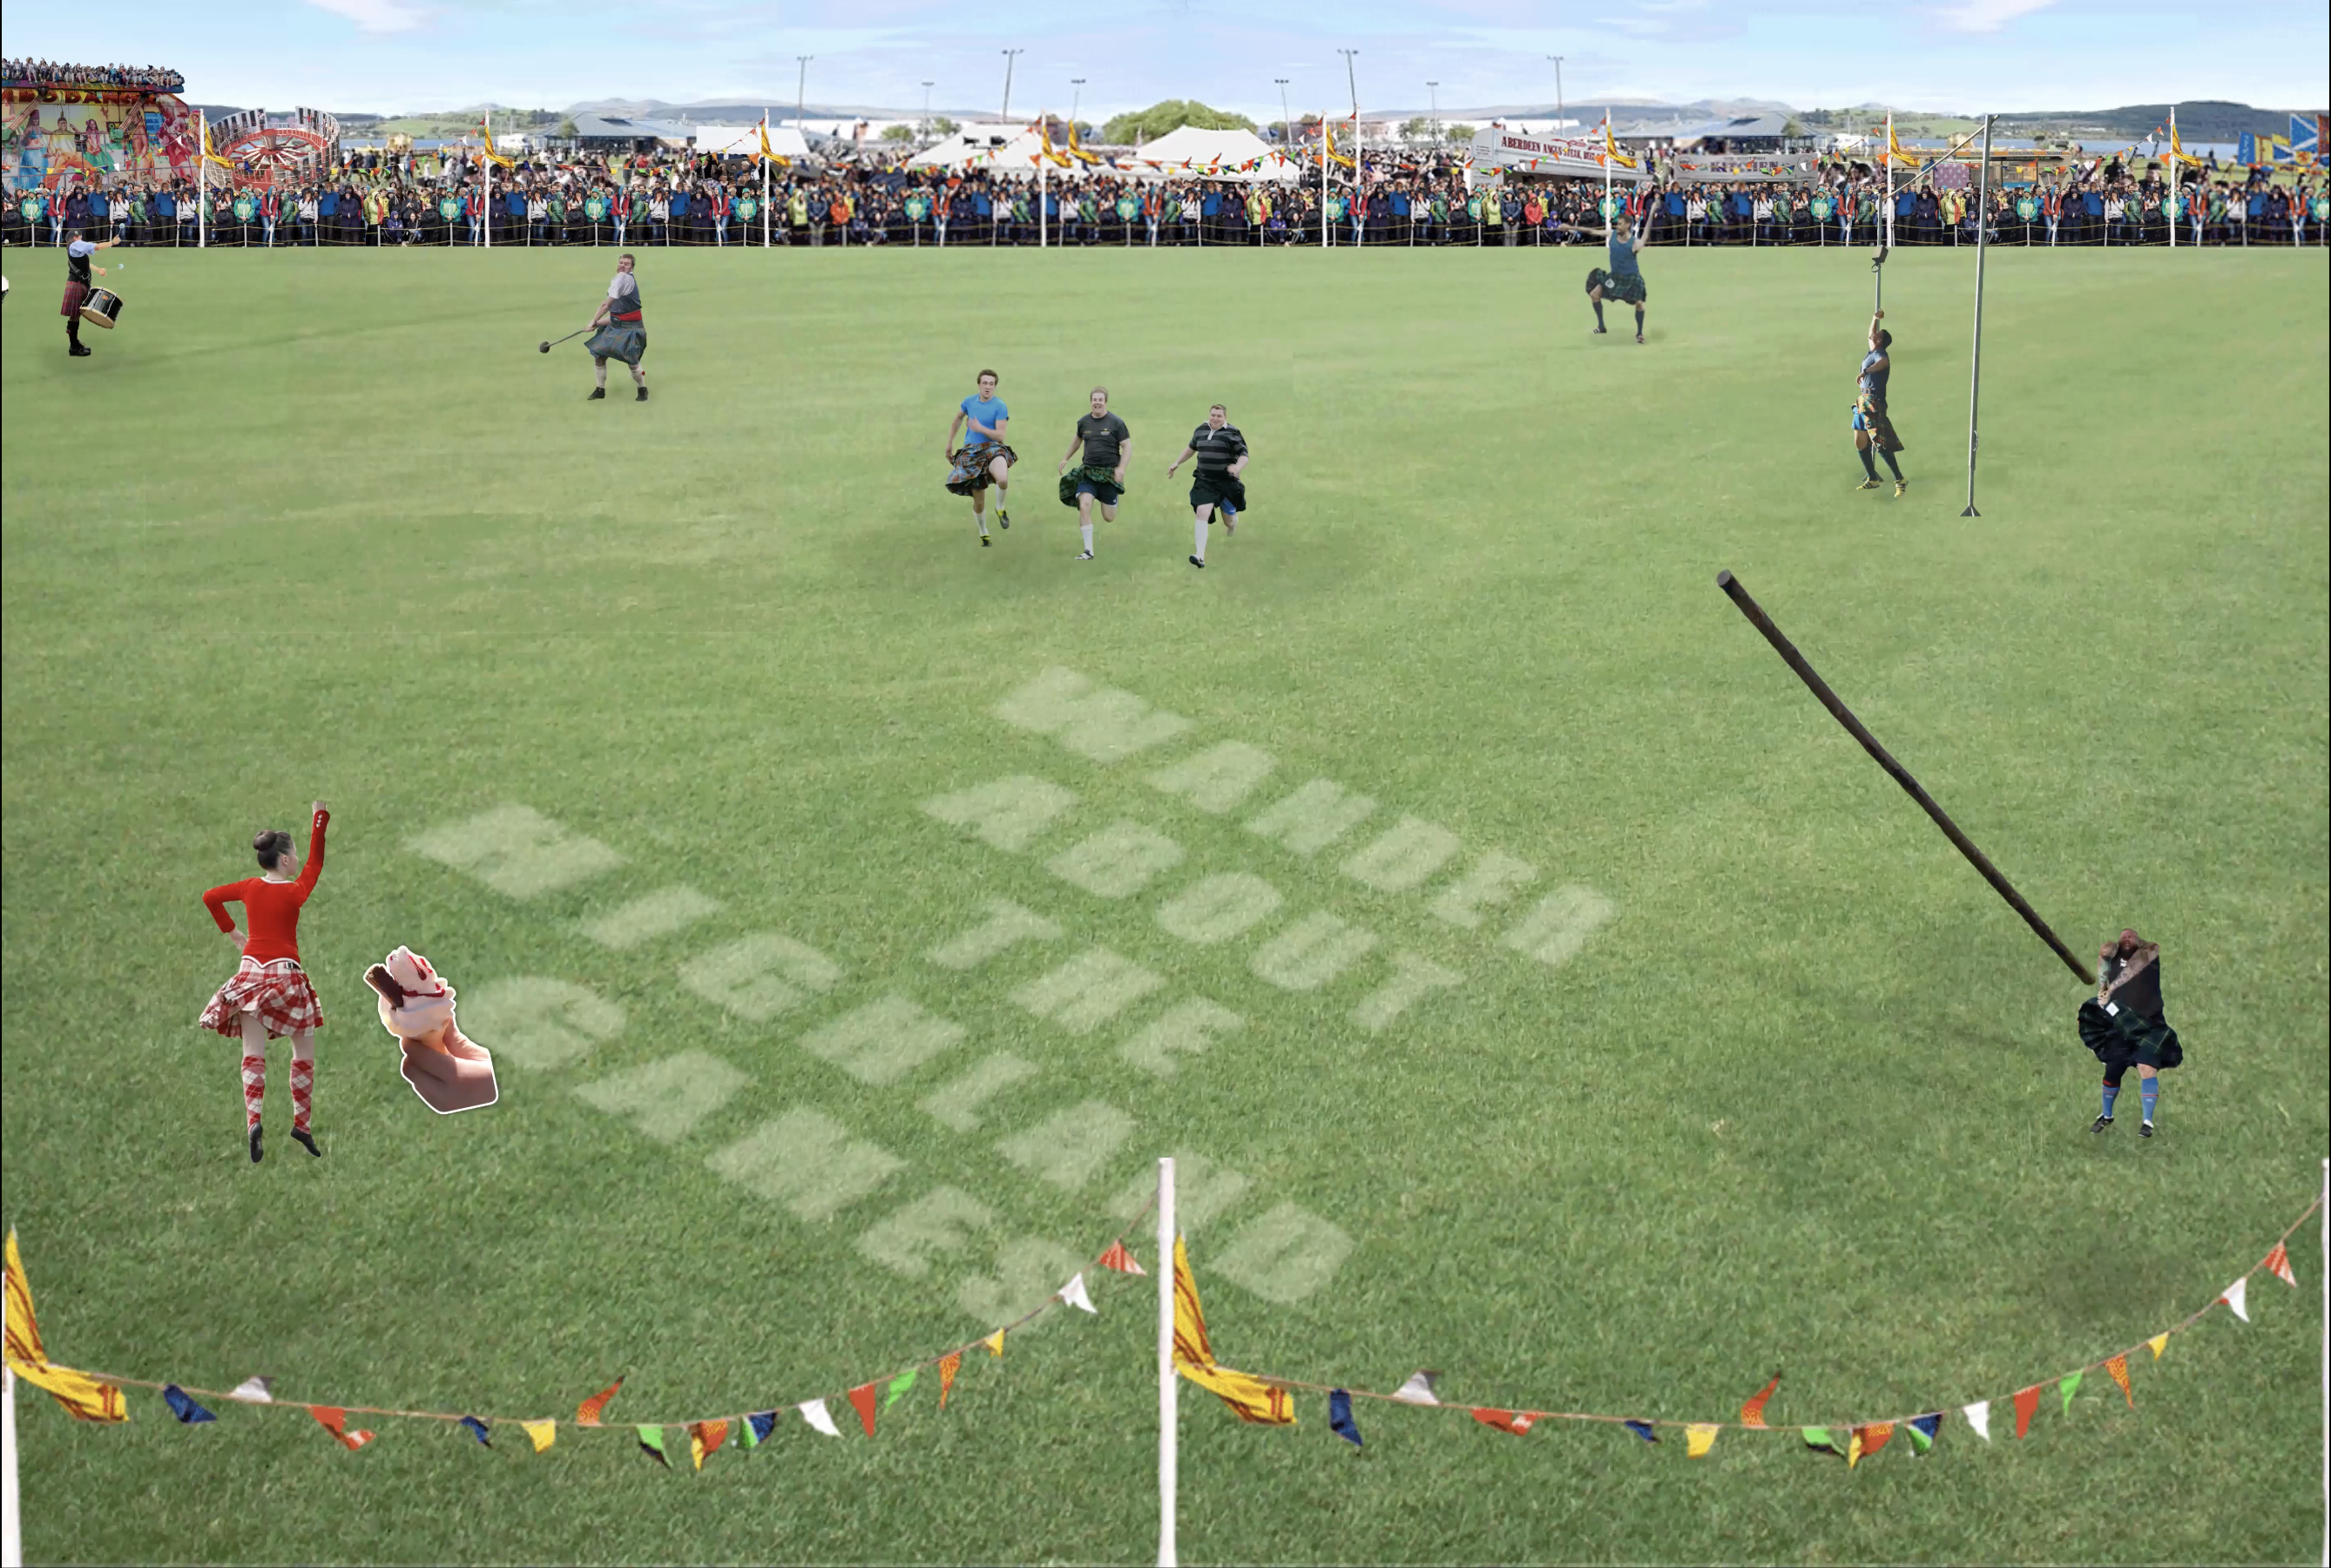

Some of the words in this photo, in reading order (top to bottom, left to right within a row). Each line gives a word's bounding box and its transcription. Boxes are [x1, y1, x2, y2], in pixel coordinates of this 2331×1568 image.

[1501, 136, 1541, 152] ABERDEEN
[1543, 144, 1563, 157] ANGUS
[916, 774, 1465, 1035] ABOUT
[990, 666, 1617, 967] WANDER
[404, 801, 1357, 1305] HIGHLAND
[925, 896, 1247, 1078] THE
[453, 974, 1087, 1333] GAMES
